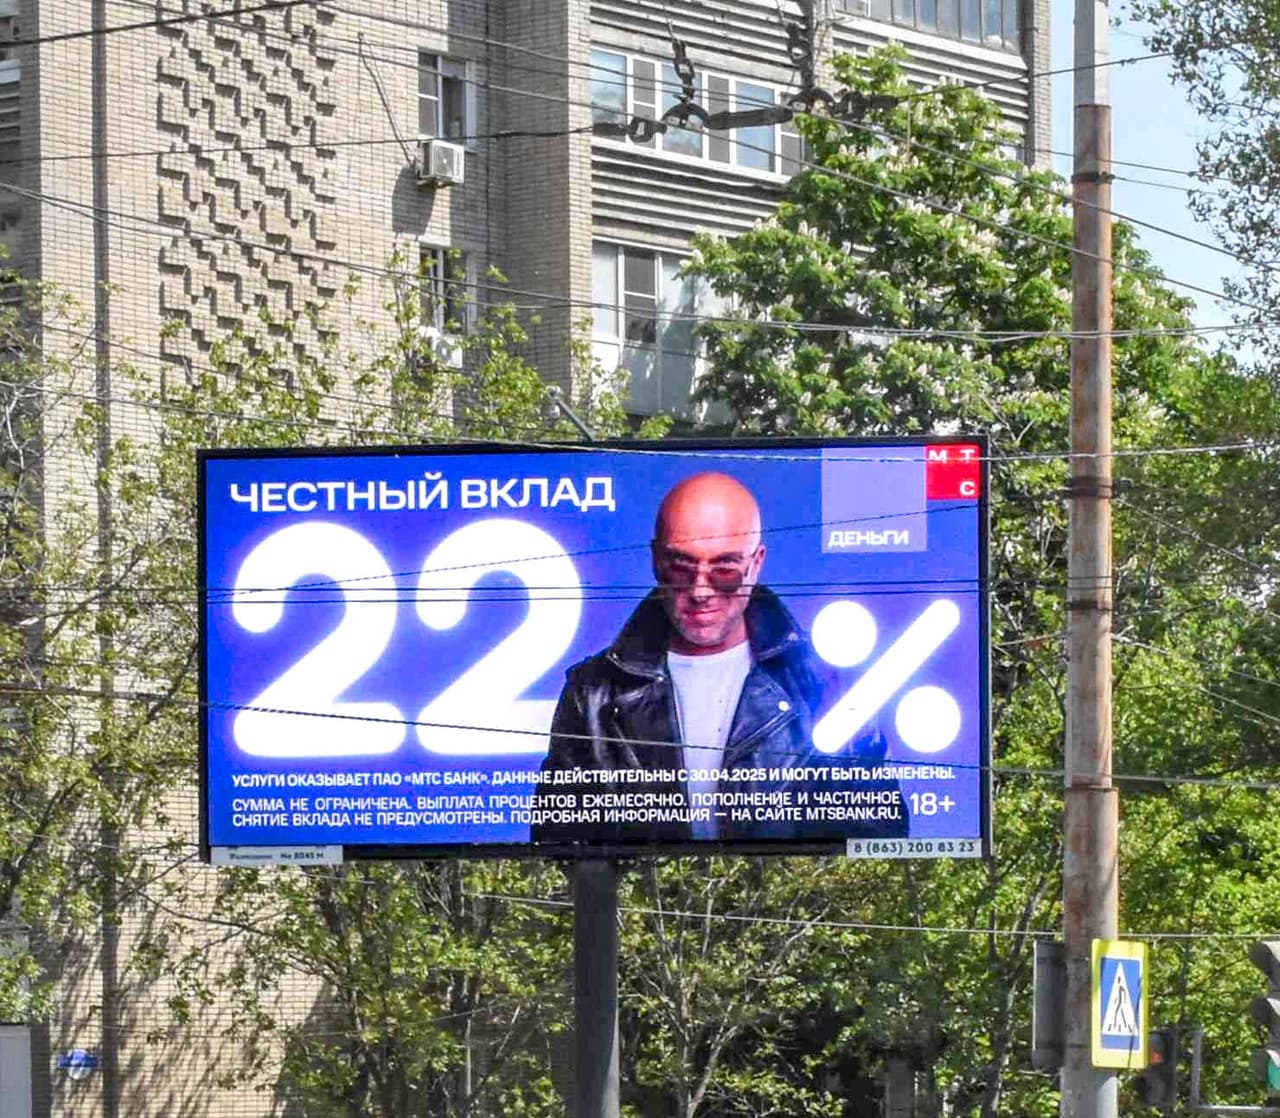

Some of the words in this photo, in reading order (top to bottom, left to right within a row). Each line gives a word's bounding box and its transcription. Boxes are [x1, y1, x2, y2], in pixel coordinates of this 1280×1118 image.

[230, 477, 450, 513] ЧЕСТНЫЙ
[459, 476, 616, 512] ВКЛАД
[828, 530, 910, 548] ДЕНЬГИ
[231, 519, 583, 758] 22
[811, 598, 962, 753] %
[232, 773, 285, 788] УСЛУГИ
[287, 772, 370, 787] ОКАЗЫВАЕТ
[372, 772, 402, 786] ПАО
[404, 772, 442, 786] «МТС
[492, 770, 552, 785] ДАННЫЕ
[553, 767, 675, 784] ДЕЙСТВИТЕЛЬНЫ
[677, 769, 687, 782] С
[689, 768, 767, 782] 30.04.2025
[769, 768, 780, 782] И
[781, 767, 830, 781] МОГУТ
[831, 767, 870, 781] БЫТЬ
[872, 766, 956, 780] ИЗМЕНЕНЫ.
[233, 798, 285, 812] СУММА
[290, 798, 308, 811] НЕ
[315, 796, 412, 810] ОГРАНИЧЕНА.
[417, 796, 484, 810] ВЫПЛАТА
[489, 794, 577, 809] ПРОЦЕНТОВ
[583, 793, 687, 807] ЕЖЕМЕСЯЧНО.
[691, 792, 791, 806] ПОПОЛНЕНИЕ
[797, 792, 808, 806] И
[813, 791, 900, 805] ЧАСТИЧНОЕ
[909, 792, 956, 816] 18+
[233, 813, 288, 827] СНЯТИЕ
[292, 812, 351, 827] ВКЛАДА
[354, 812, 372, 825] НЕ
[377, 811, 507, 826] ПРЕДУСМОТРЕНЫ.
[510, 810, 600, 825] ПОДРОБНАЯ
[604, 808, 710, 823] ИНФОРМАЦИЯ
[731, 808, 749, 820] НА
[755, 805, 802, 821] САЙТЕ
[854, 842, 862, 853] 8
[866, 841, 903, 855] (863)
[908, 842, 933, 853] 200
[938, 842, 954, 853] 83
[958, 842, 975, 853] 23
